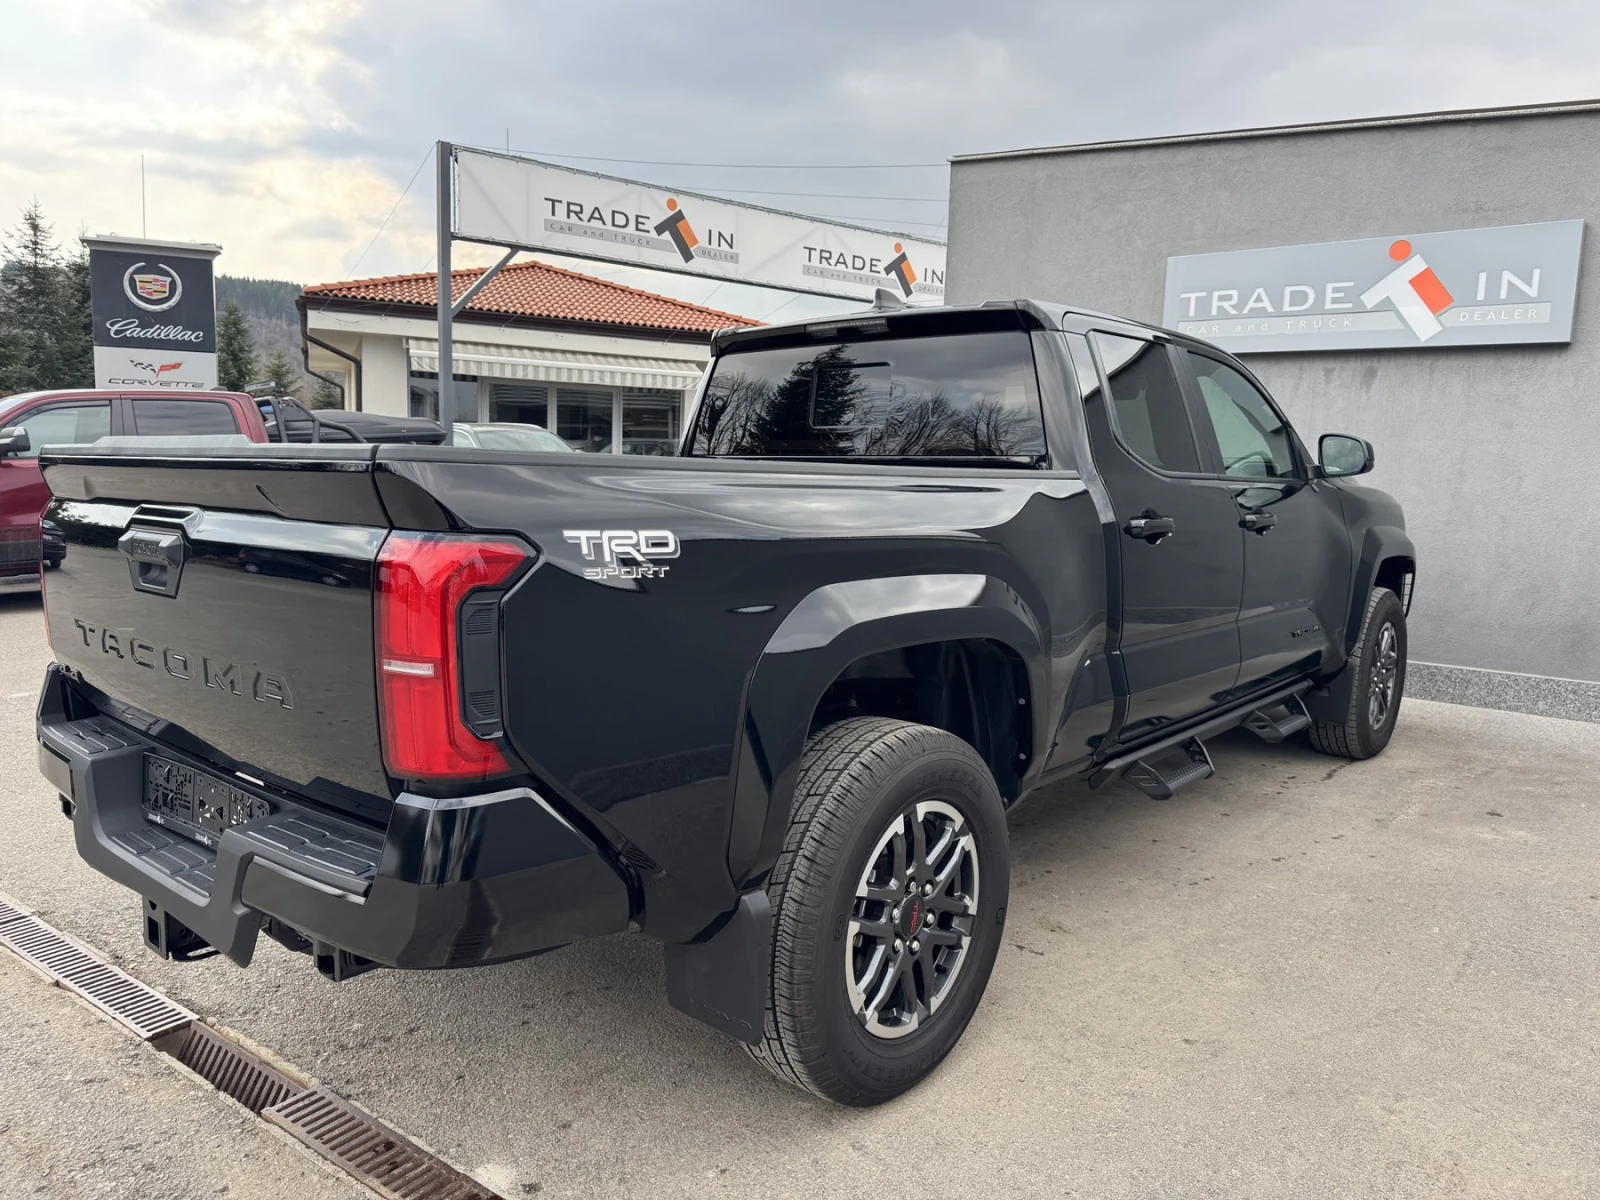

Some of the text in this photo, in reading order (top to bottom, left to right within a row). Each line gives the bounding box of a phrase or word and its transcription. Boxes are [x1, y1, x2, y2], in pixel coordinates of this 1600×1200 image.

[544, 197, 650, 234] TRADE
[708, 228, 734, 250] IN
[549, 222, 735, 261] CAR and TRUCK DEALER
[803, 246, 882, 274] TRADE
[924, 267, 944, 285] IN
[806, 267, 824, 276] CAR
[853, 275, 881, 285] TRUCK
[1180, 281, 1355, 318] TRADE
[1476, 268, 1541, 301] IN
[106, 318, 204, 342] Cadillac
[1186, 308, 1538, 335] CAR and TRUCK DEALER
[108, 377, 205, 389] CORVETTE
[562, 529, 681, 567] TRD
[582, 565, 670, 580] SPORT
[74, 618, 294, 710] TACOMA
